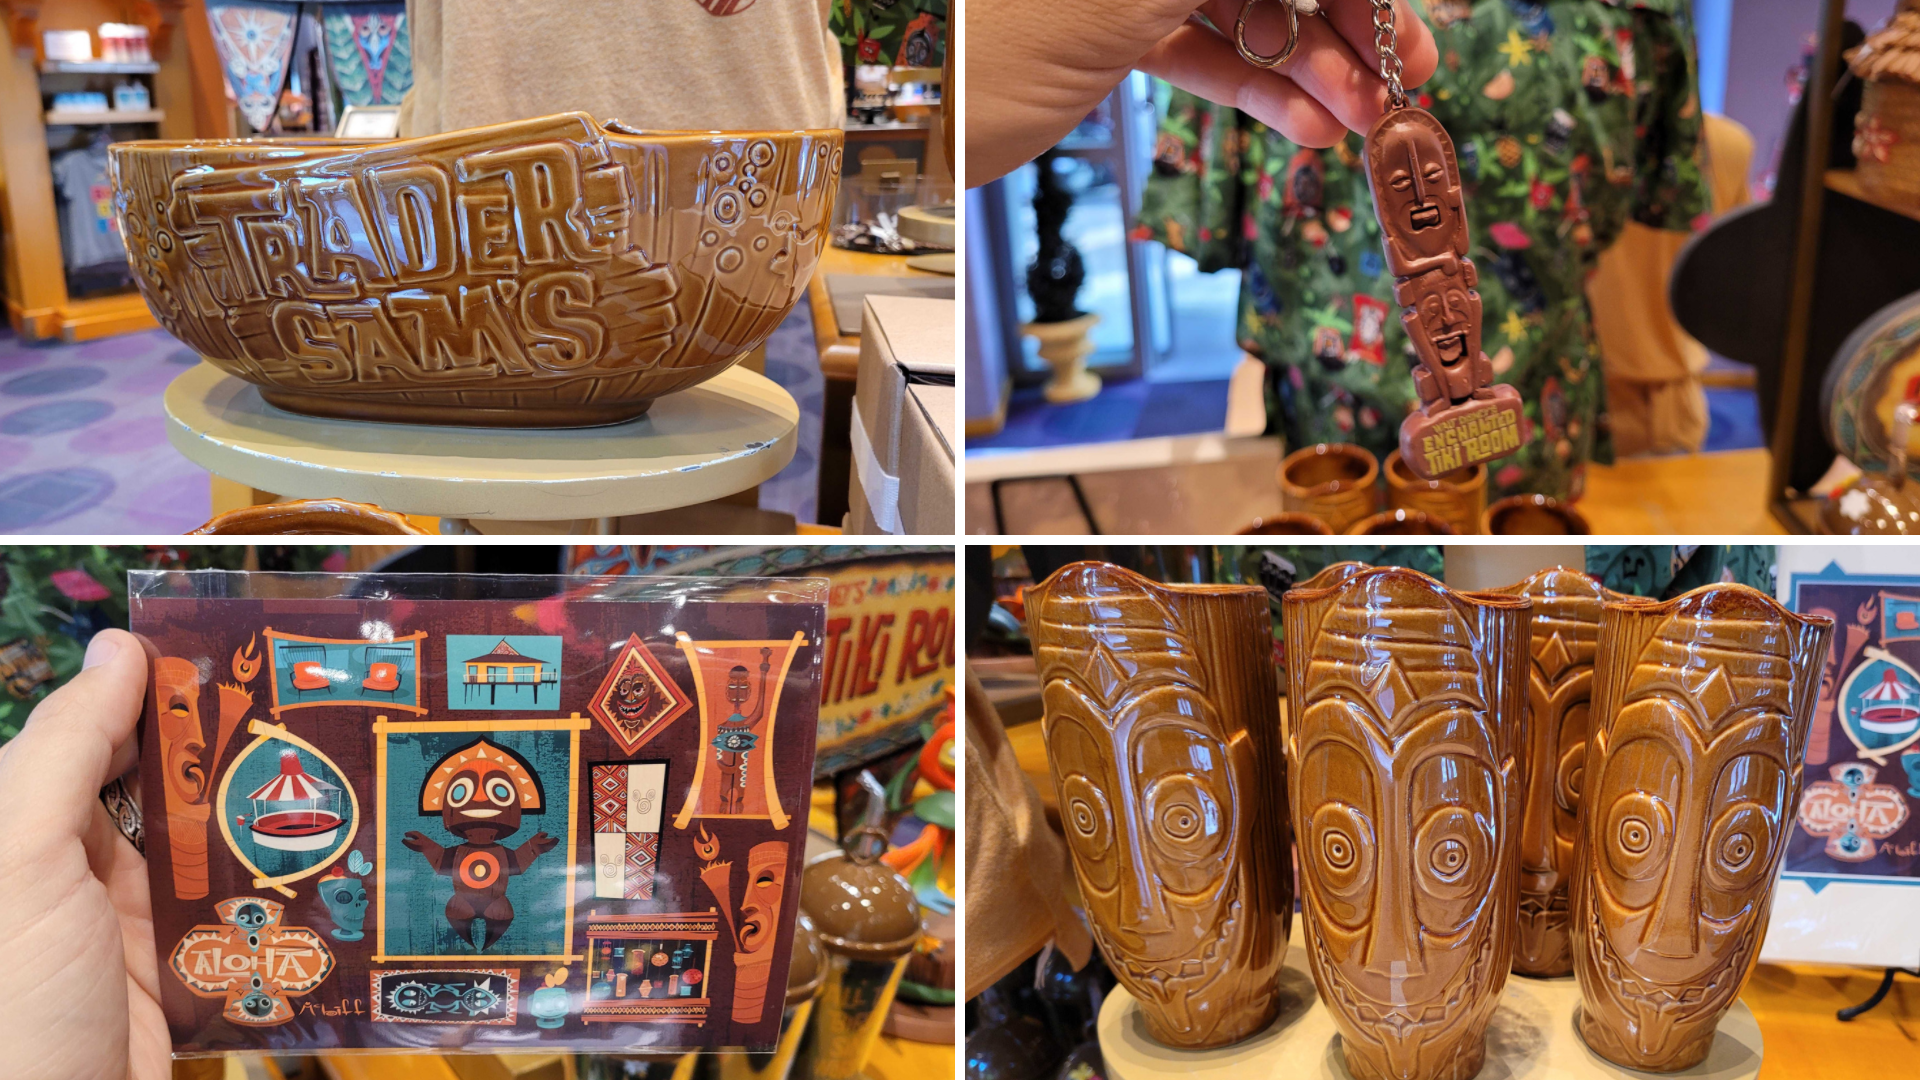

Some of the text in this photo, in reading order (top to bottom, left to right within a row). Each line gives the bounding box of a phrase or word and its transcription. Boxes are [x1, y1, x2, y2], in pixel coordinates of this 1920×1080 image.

[187, 139, 613, 302] TRADER
[271, 270, 605, 383] SAM'S
[1422, 408, 1517, 453] ENCHANTED
[1461, 423, 1521, 462] ROOM
[1808, 798, 1896, 825] ALOHA
[190, 946, 313, 979] ALOHA
